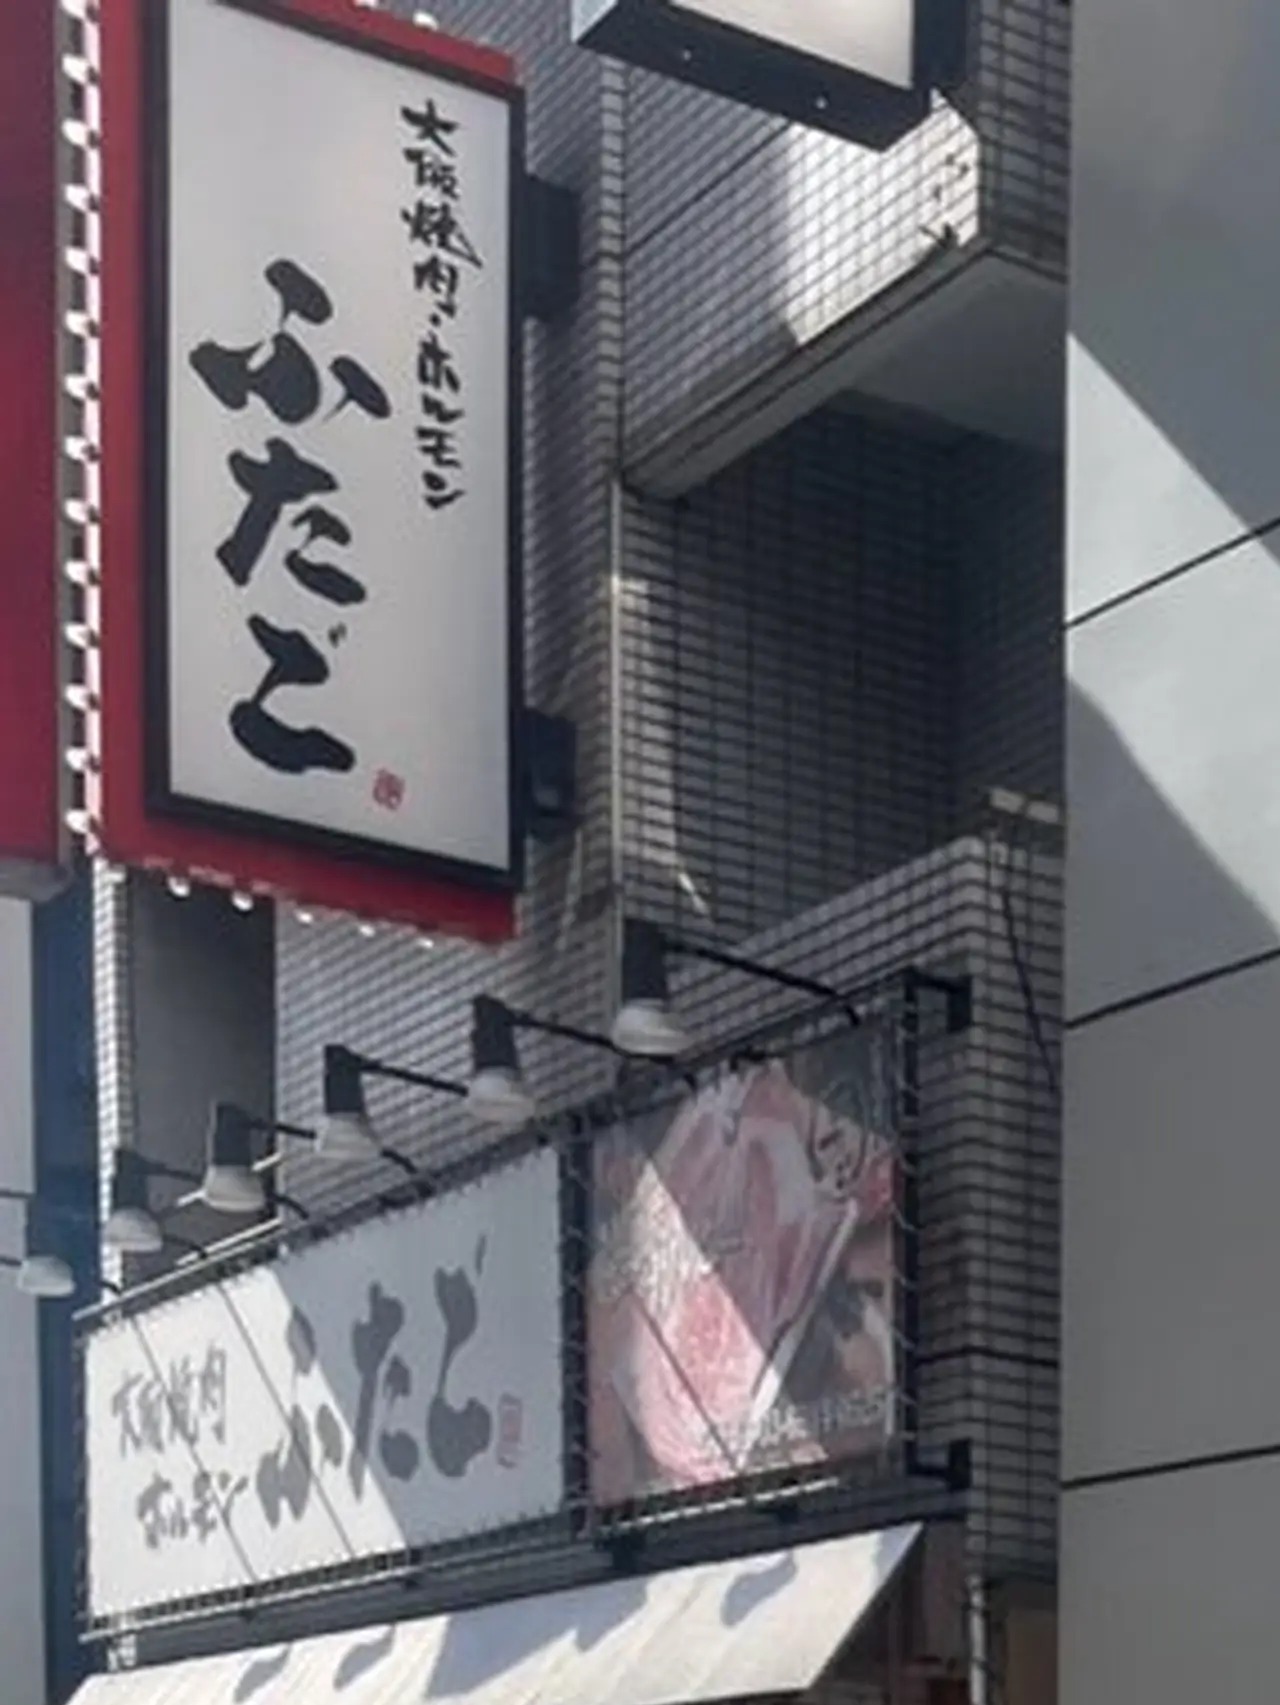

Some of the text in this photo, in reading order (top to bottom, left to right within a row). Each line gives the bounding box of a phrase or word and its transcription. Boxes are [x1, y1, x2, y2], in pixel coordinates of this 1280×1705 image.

[189, 259, 390, 776] ふたご
[256, 1236, 493, 1530] ふたご
